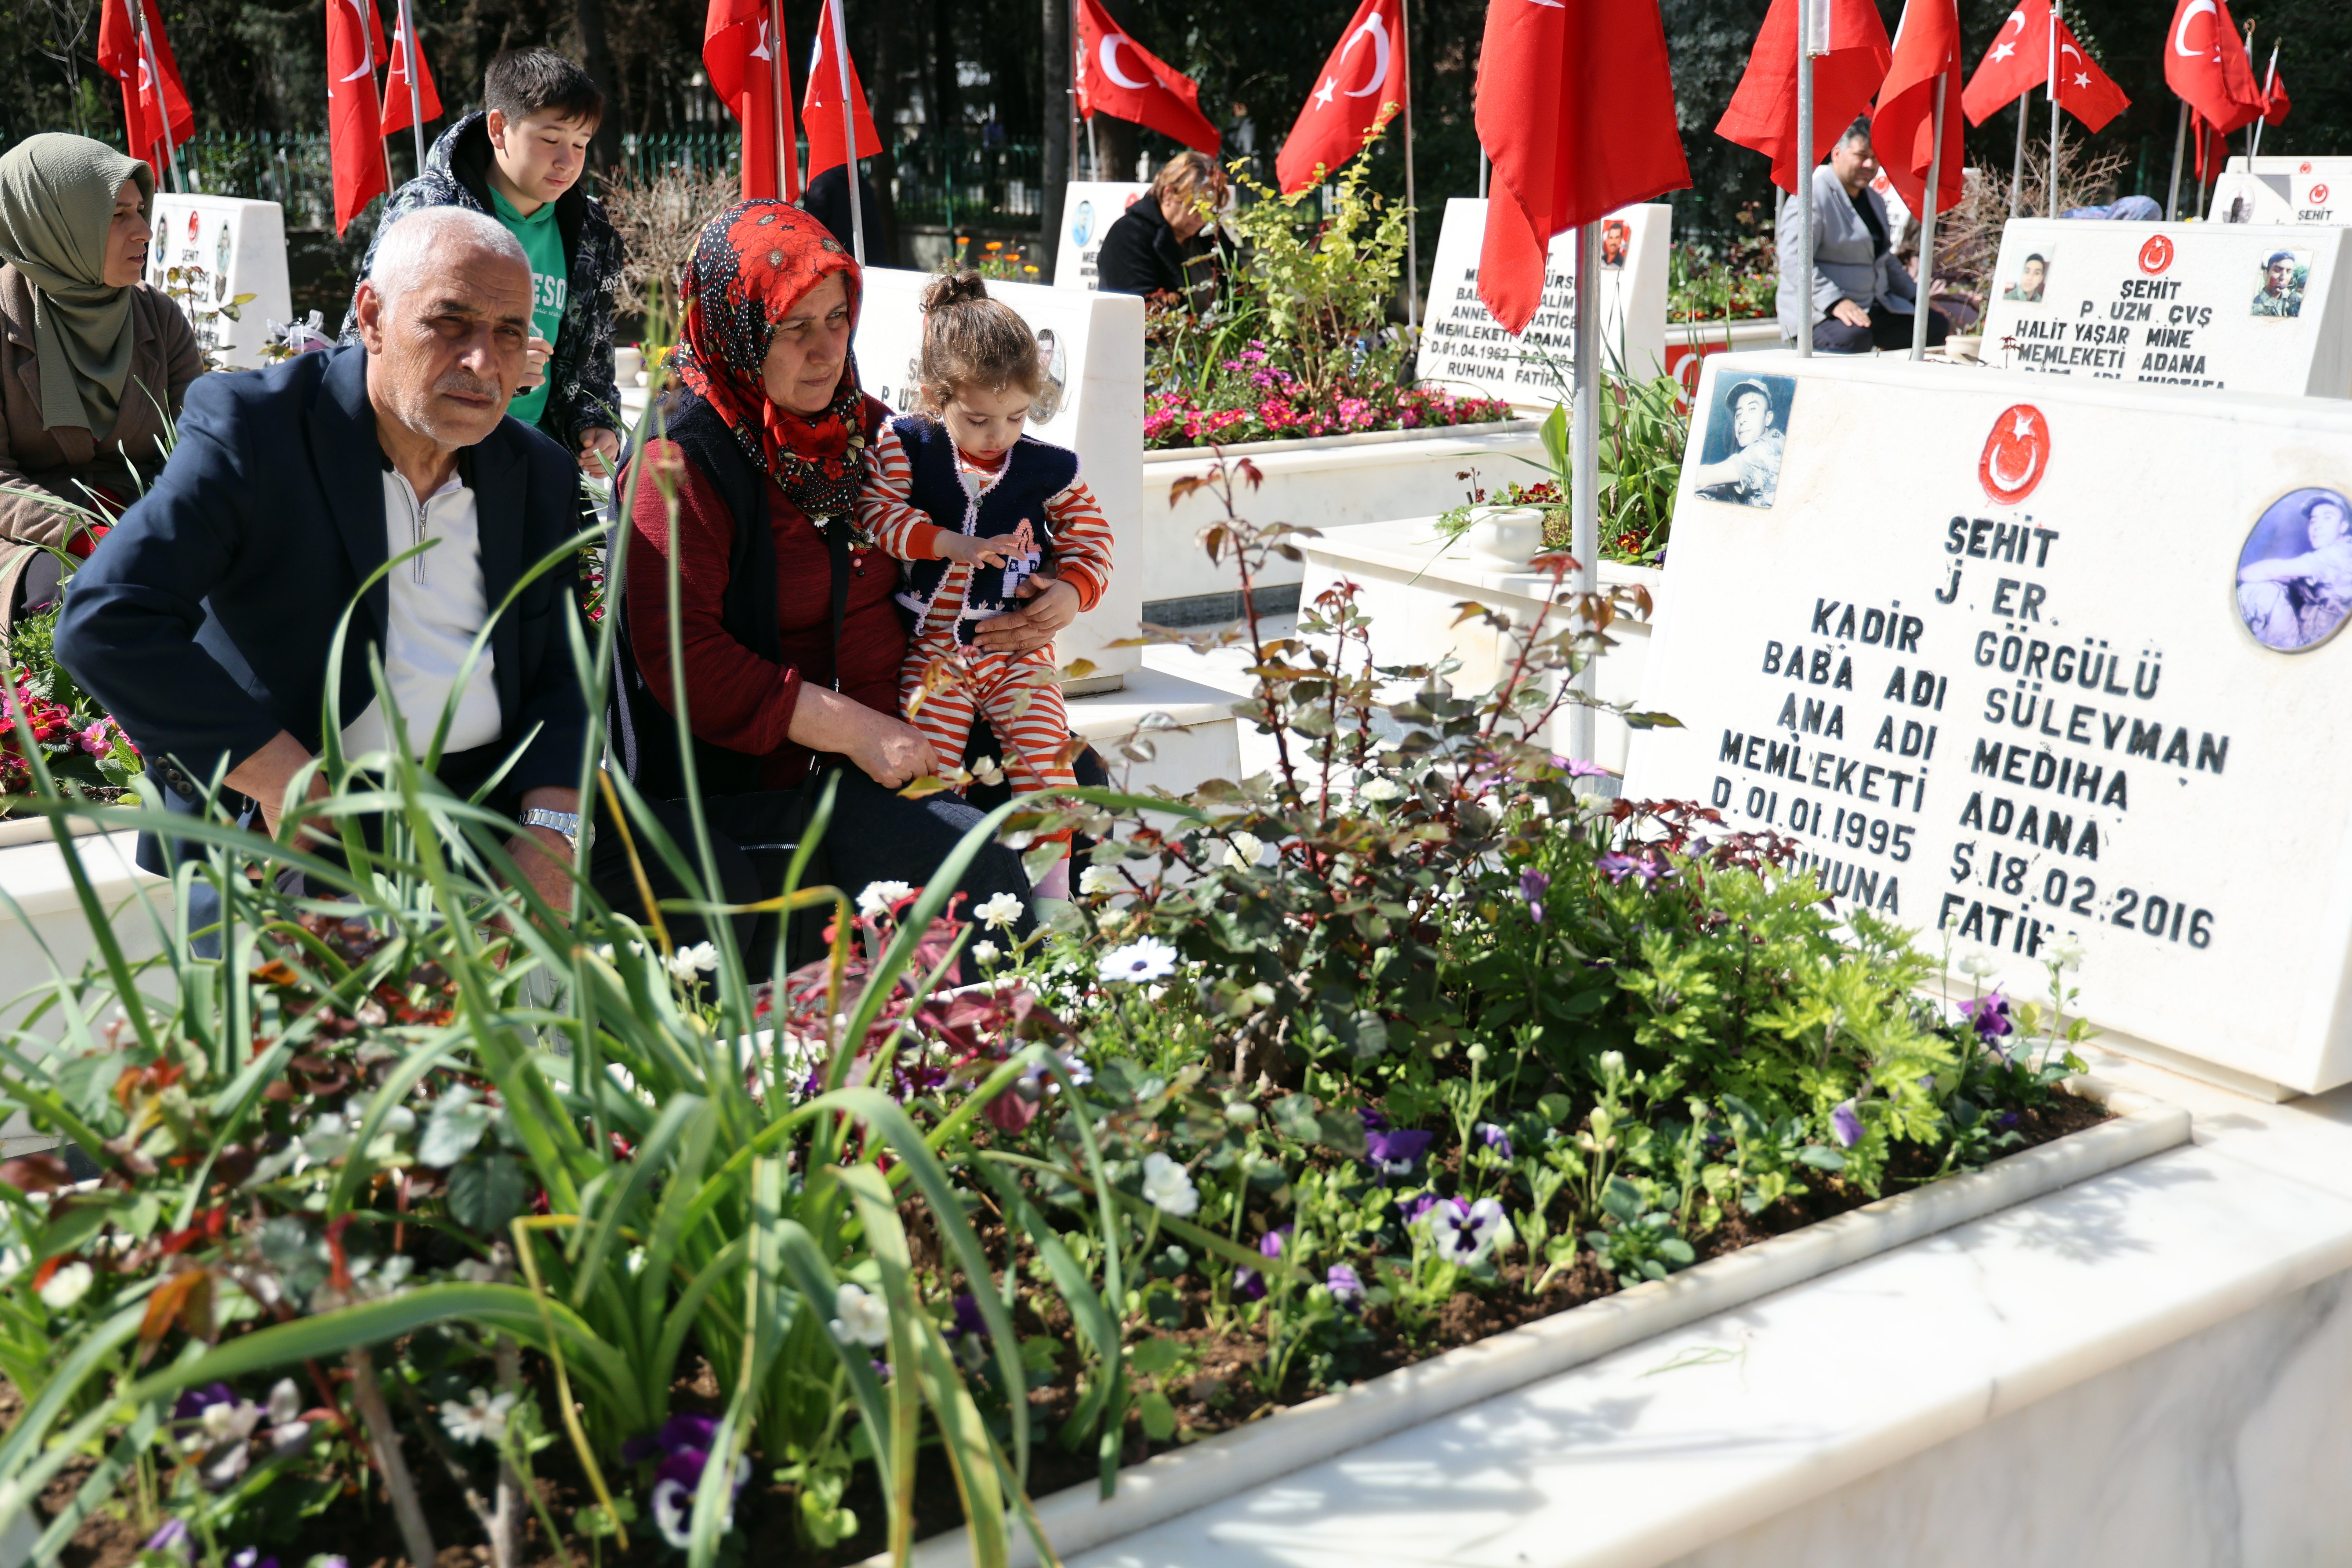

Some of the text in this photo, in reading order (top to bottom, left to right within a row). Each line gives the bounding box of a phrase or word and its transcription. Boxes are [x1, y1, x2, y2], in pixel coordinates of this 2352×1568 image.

[2120, 277, 2181, 299] ŞEHİT
[1451, 306, 1488, 322] ANNE
[1523, 332, 1572, 349] ADANA
[2015, 317, 2194, 348] HALİT YAŞAR MİNE
[2018, 343, 2206, 374] MEMLEKETİ ADANA
[1447, 362, 1565, 388] RUHUNA FATİHA
[1810, 597, 2162, 700] KADİR GÖRGÜLÜ
[1762, 639, 2230, 774] BABA ADI SÜLEYMAN
[1776, 691, 1843, 740] ANA
[1873, 715, 1938, 760] ADI
[1718, 728, 2099, 862] MEMLEKETİ ADANA
[1786, 847, 2078, 958] UHUNA FATİH
